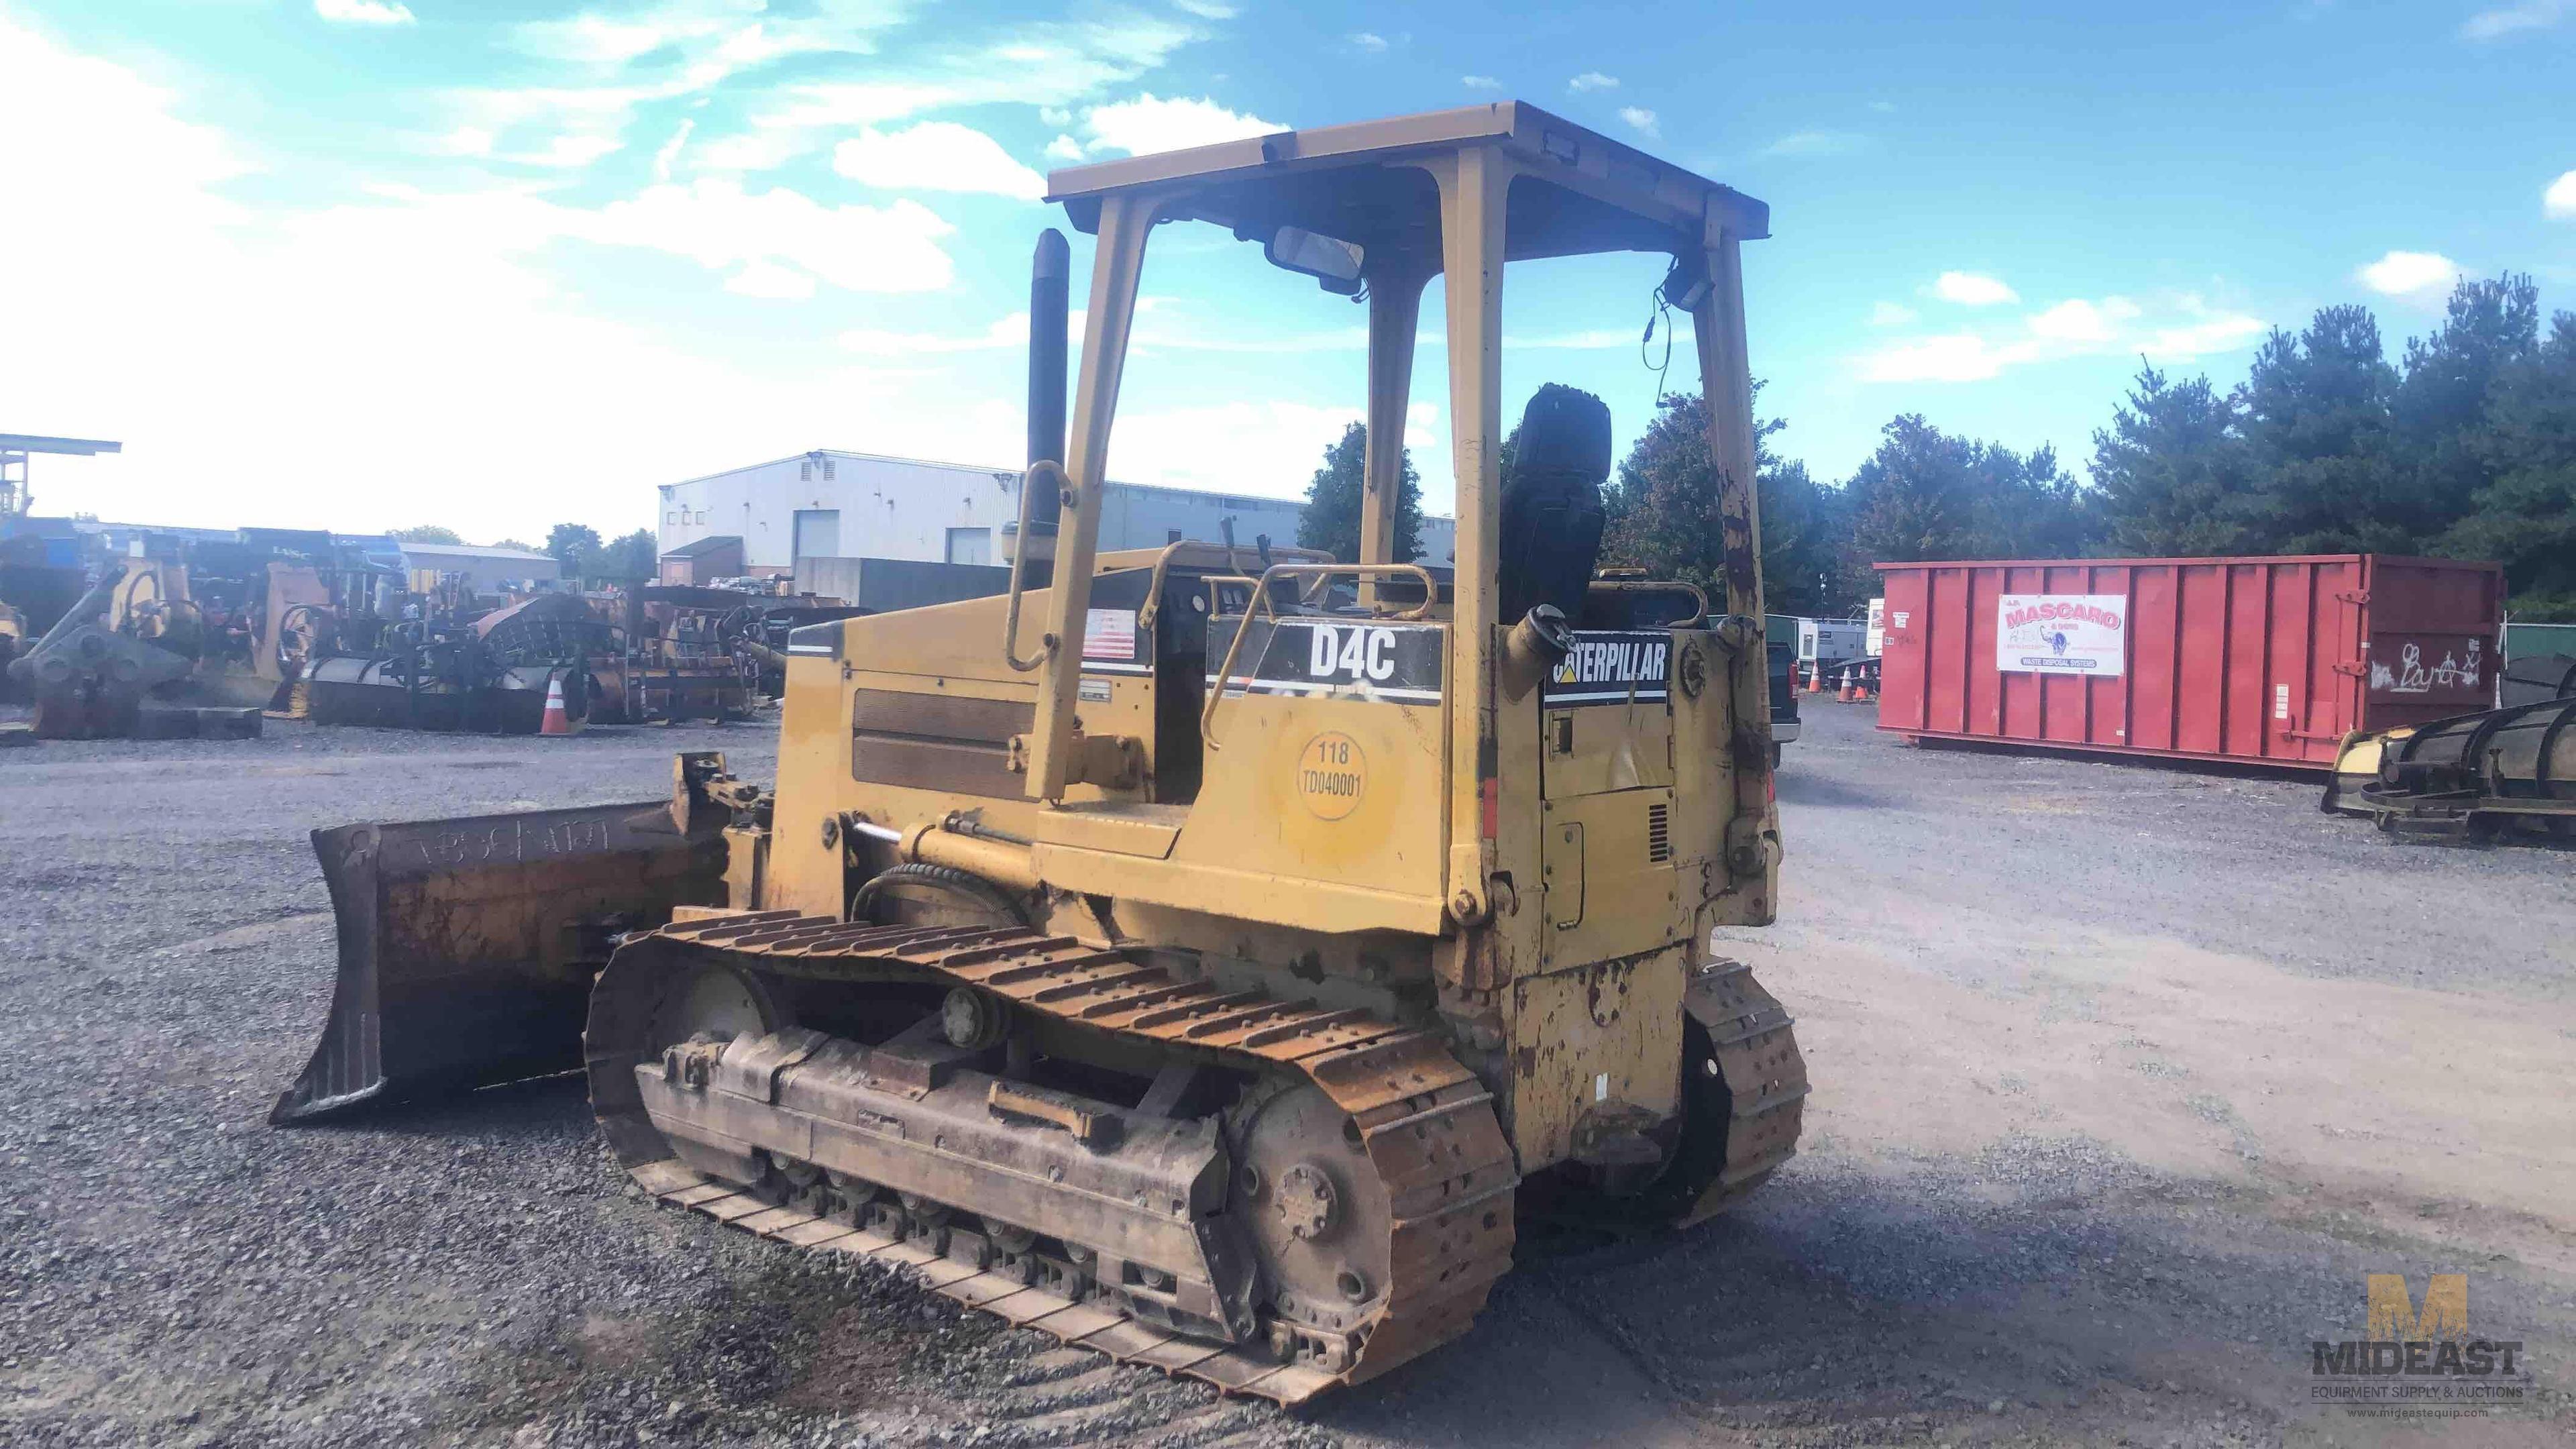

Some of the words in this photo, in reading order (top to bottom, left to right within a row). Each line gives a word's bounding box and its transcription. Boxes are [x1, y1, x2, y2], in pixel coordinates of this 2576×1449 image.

[2005, 602, 2121, 630] MASCARO
[1310, 625, 1396, 680] D4C
[2023, 657, 2041, 666] WASTE
[2043, 658, 2070, 667] DISPOSAL
[2070, 659, 2096, 668] SYSTEMS
[1319, 741, 1349, 765] 118
[1303, 769, 1361, 798] TD040001
